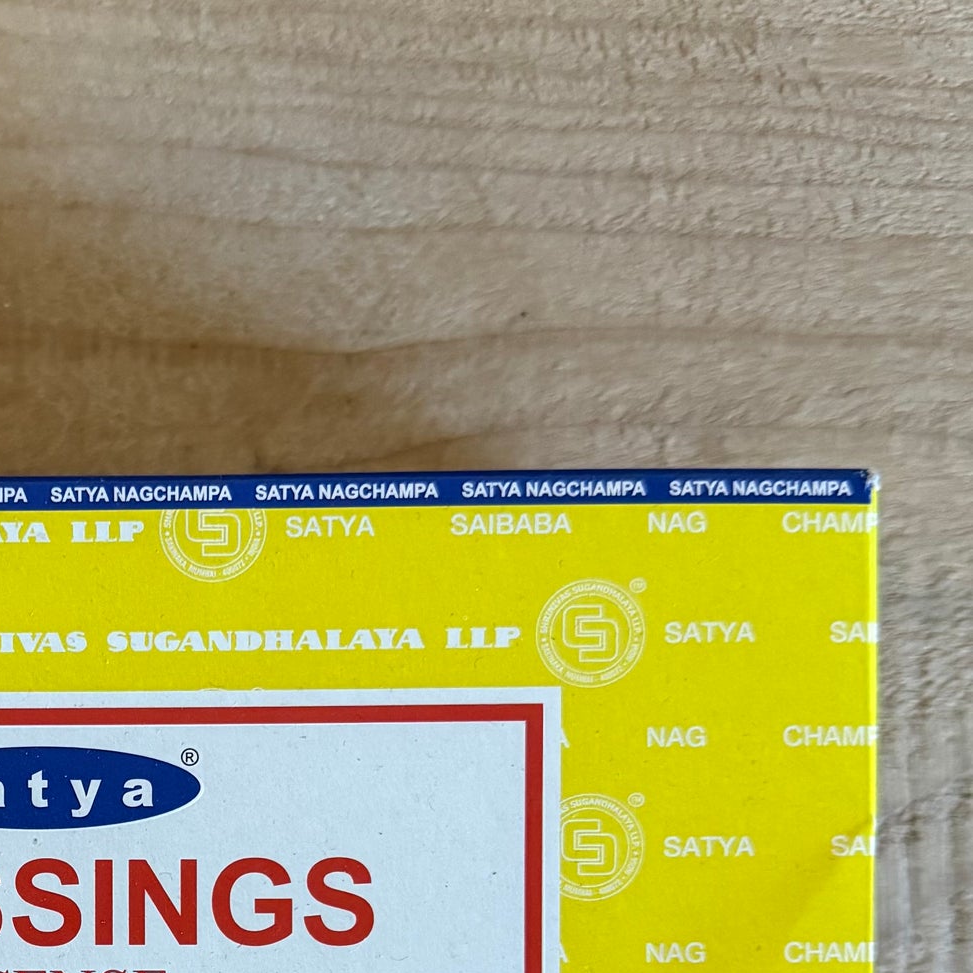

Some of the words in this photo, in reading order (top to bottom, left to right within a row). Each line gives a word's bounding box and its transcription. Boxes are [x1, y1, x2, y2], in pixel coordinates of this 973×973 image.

[51, 487, 108, 502] SATYA
[114, 486, 231, 501] NAGCHAMPA
[256, 485, 314, 500] SATYA
[319, 483, 438, 499] NAGCHAMPA
[462, 482, 520, 497] SATYA
[527, 481, 645, 496] NAGCHAMPA
[670, 480, 728, 495] SATYA
[733, 480, 850, 496] NAGCHAMPA
[71, 521, 144, 542] LLP
[286, 516, 374, 537] SATYA
[451, 513, 571, 535] SAIBABA
[648, 511, 706, 533] NAG
[107, 629, 424, 652] SUGANDHALAYA
[446, 627, 521, 648] LLP
[665, 622, 754, 643] SATYA
[647, 726, 706, 747] NAG
[664, 836, 754, 857] SATYA
[646, 942, 705, 963] NAG
